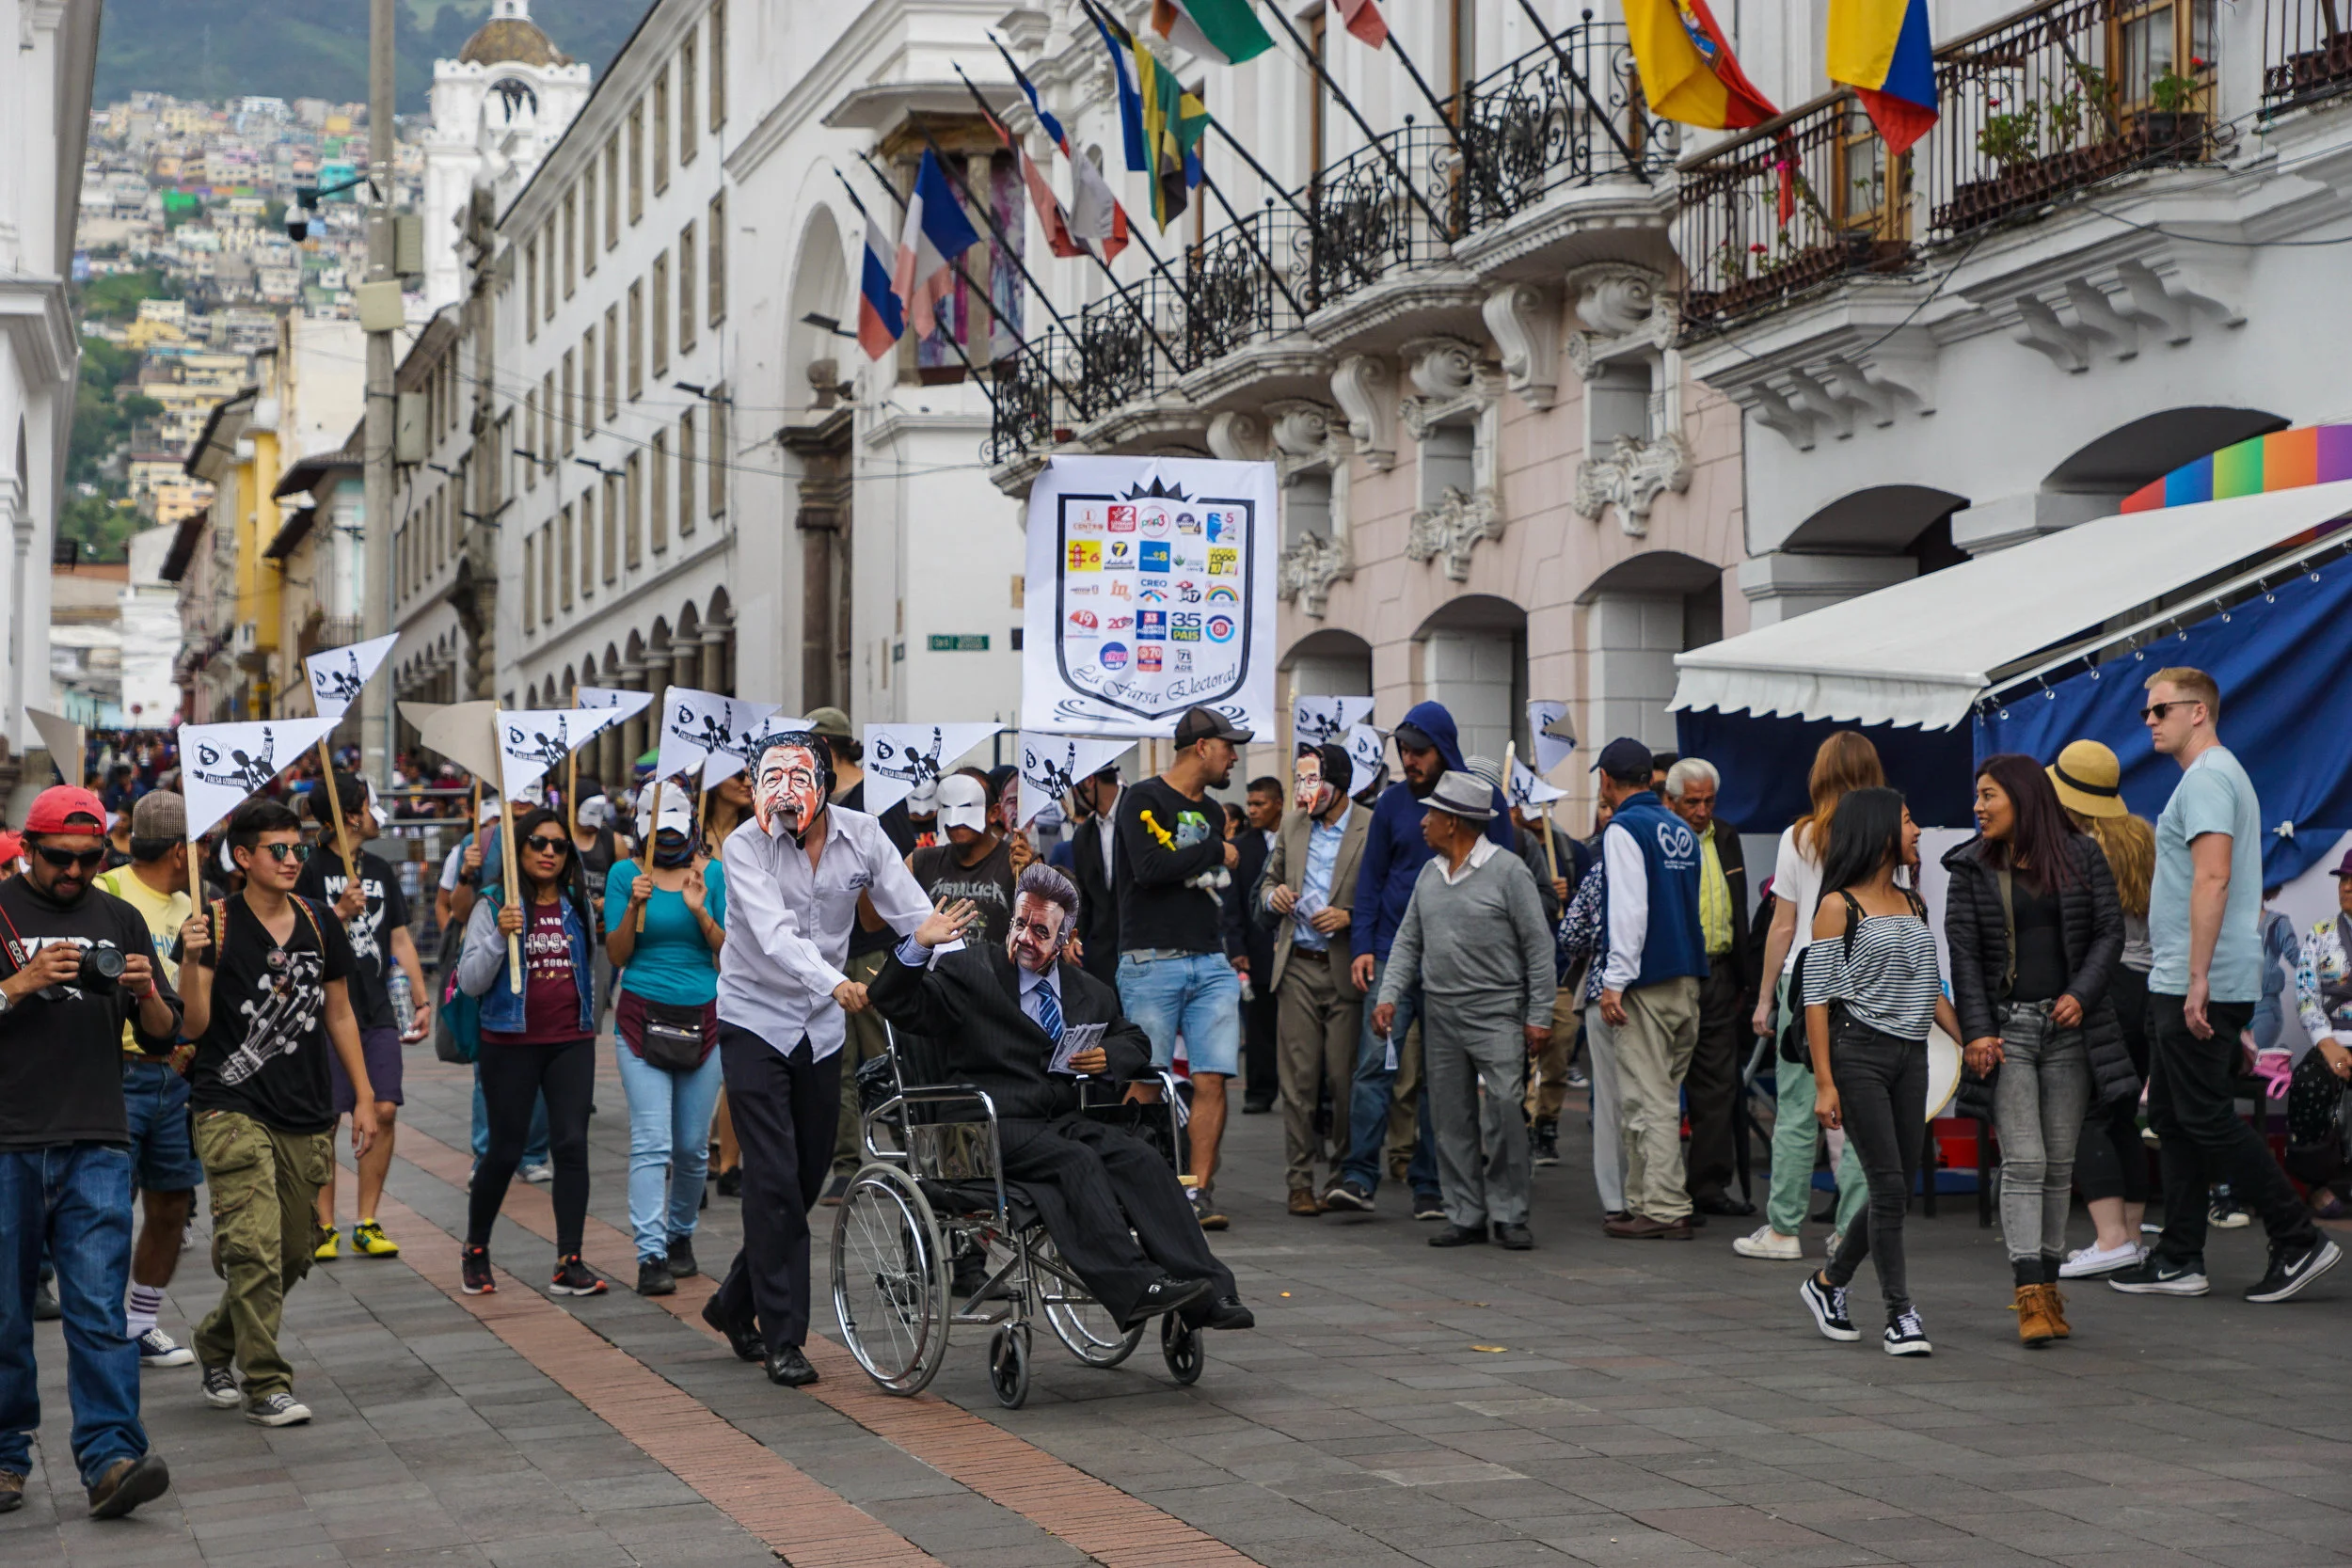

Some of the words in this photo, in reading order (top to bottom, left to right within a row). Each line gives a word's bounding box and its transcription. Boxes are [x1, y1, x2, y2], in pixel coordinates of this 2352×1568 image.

[1225, 512, 1233, 523] 5
[1114, 543, 1126, 557] 7
[1172, 612, 1201, 627] 35
[1073, 664, 1102, 684] La
[1103, 679, 1161, 705] Farsa
[1166, 663, 1236, 701] Electoral
[207, 776, 223, 785] FALSA
